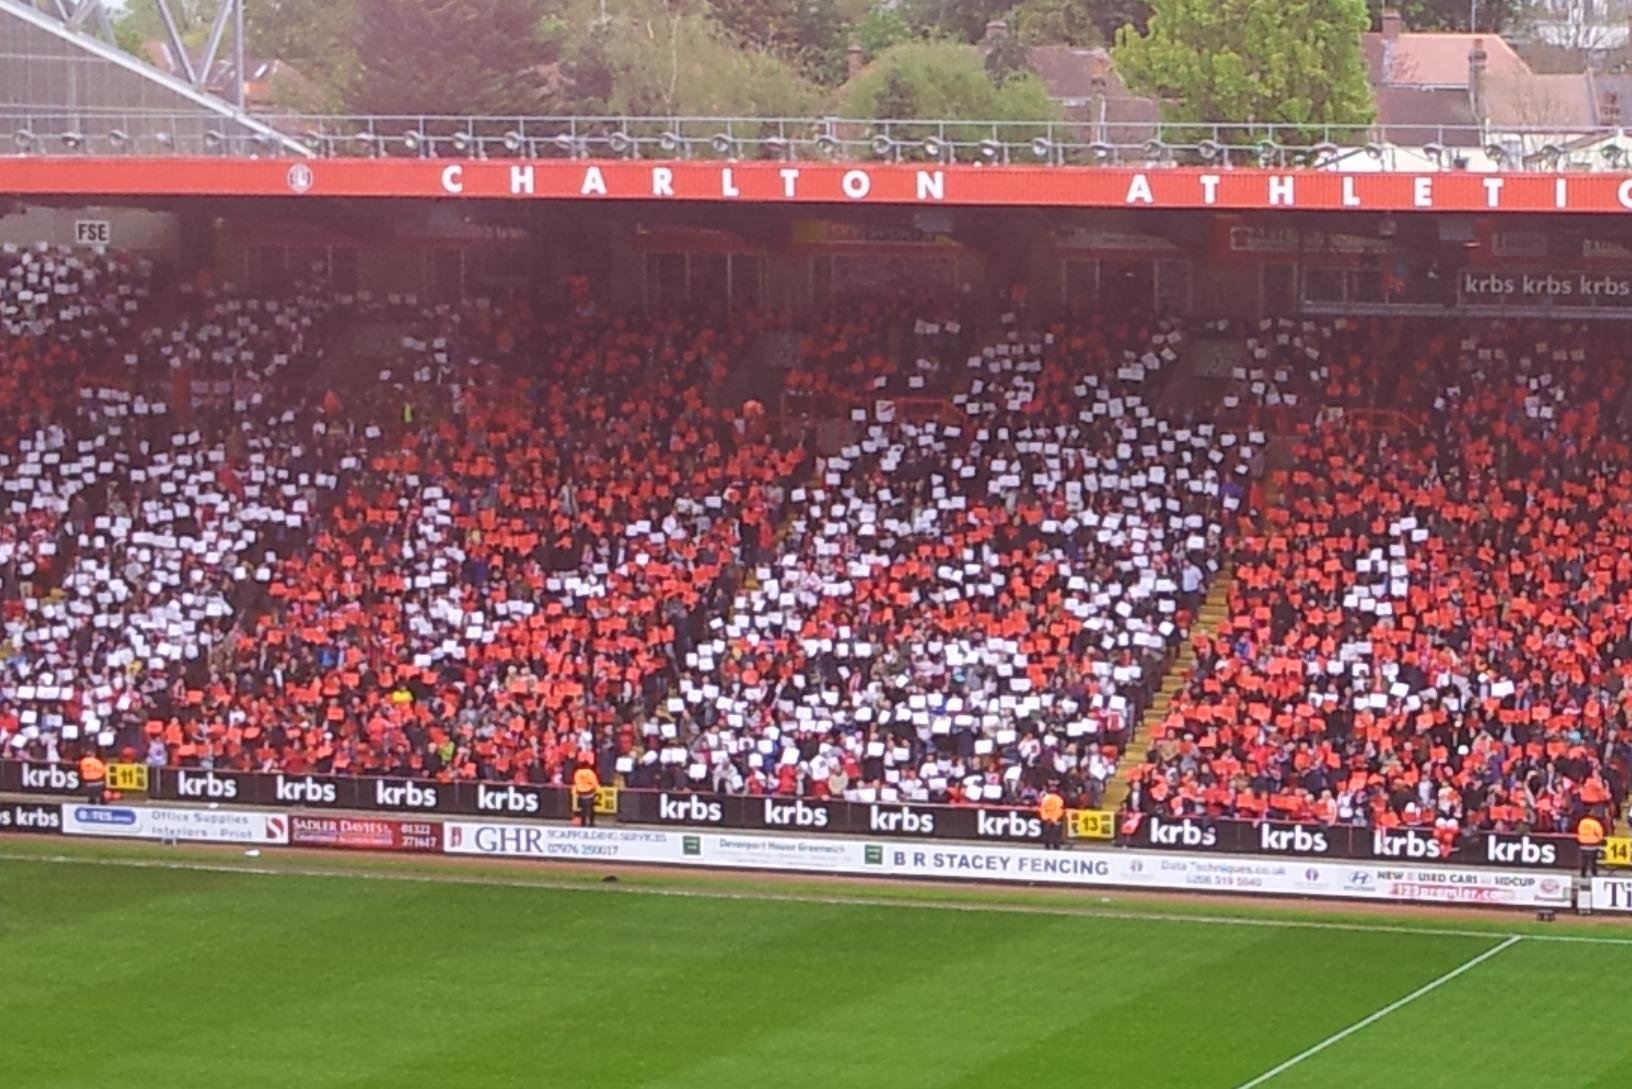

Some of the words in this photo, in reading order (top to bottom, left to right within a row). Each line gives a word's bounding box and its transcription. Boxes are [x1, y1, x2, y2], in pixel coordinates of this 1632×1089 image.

[441, 166, 945, 199] CHARLTON
[77, 223, 108, 241] FSE
[1465, 273, 1515, 294] krbs
[1522, 275, 1572, 295] krbs
[1579, 276, 1631, 297] krbs
[22, 762, 79, 789] krbs
[178, 769, 237, 798] krbs
[276, 774, 336, 802] krbs
[376, 779, 437, 807] krbs
[477, 783, 538, 812] krbs
[659, 792, 722, 821] krbs
[15, 806, 59, 827] krbs
[151, 810, 189, 821] Office
[193, 812, 249, 825] Supplies
[764, 798, 828, 827] krbs
[870, 805, 934, 833] krbs
[977, 808, 1042, 838] krbs
[1081, 816, 1099, 831] 13
[475, 827, 543, 853] GHR
[1150, 817, 1217, 846] krbs
[1261, 822, 1328, 852] krbs
[1373, 829, 1440, 858] krbs
[893, 851, 906, 866] B
[913, 852, 926, 867] R
[933, 853, 1011, 871] STACEY
[1018, 857, 1109, 876] FENCING
[1487, 835, 1556, 864] krbs
[1610, 843, 1628, 860] 14
[1377, 870, 1404, 881] NEW
[1418, 872, 1447, 883] USED
[1449, 873, 1478, 885] CARS
